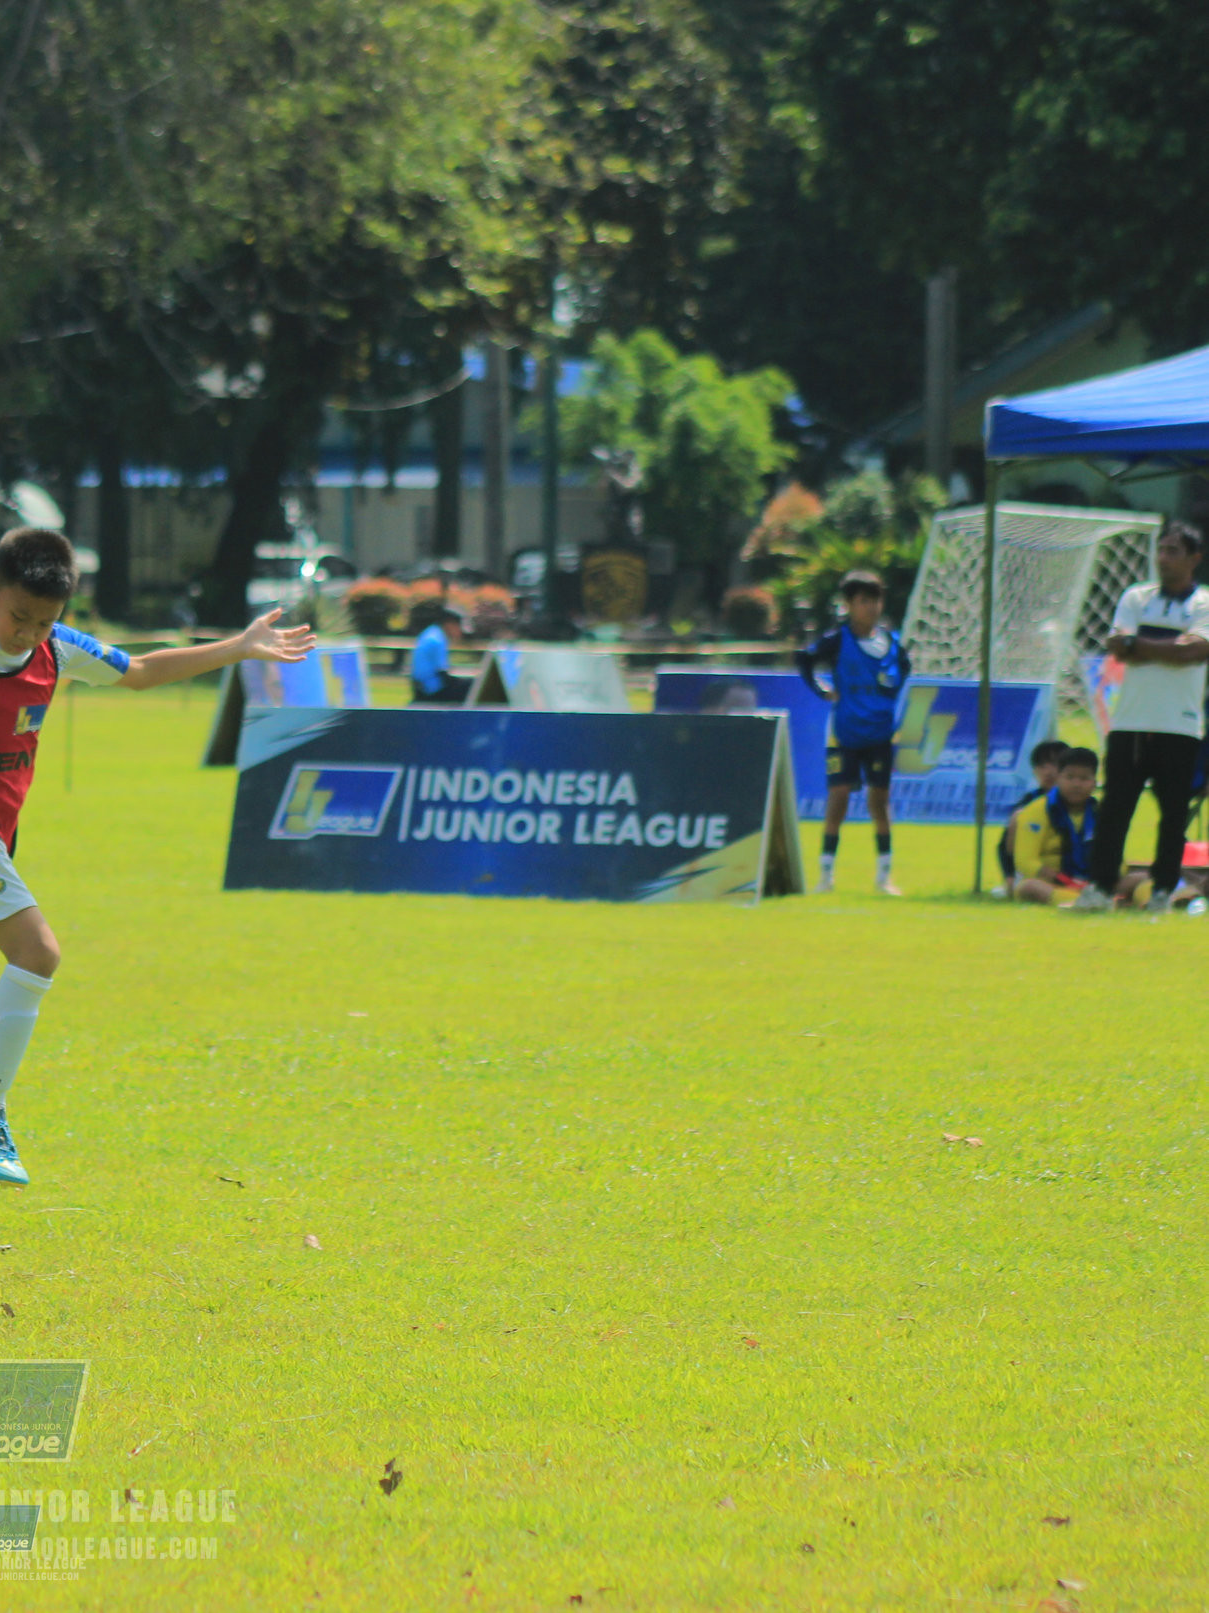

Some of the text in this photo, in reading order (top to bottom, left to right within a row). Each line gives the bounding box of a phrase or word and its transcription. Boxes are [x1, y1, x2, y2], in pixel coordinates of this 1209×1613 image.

[418, 767, 638, 806] INDONESIA
[411, 808, 728, 849] JUNIOR LEAGUE
